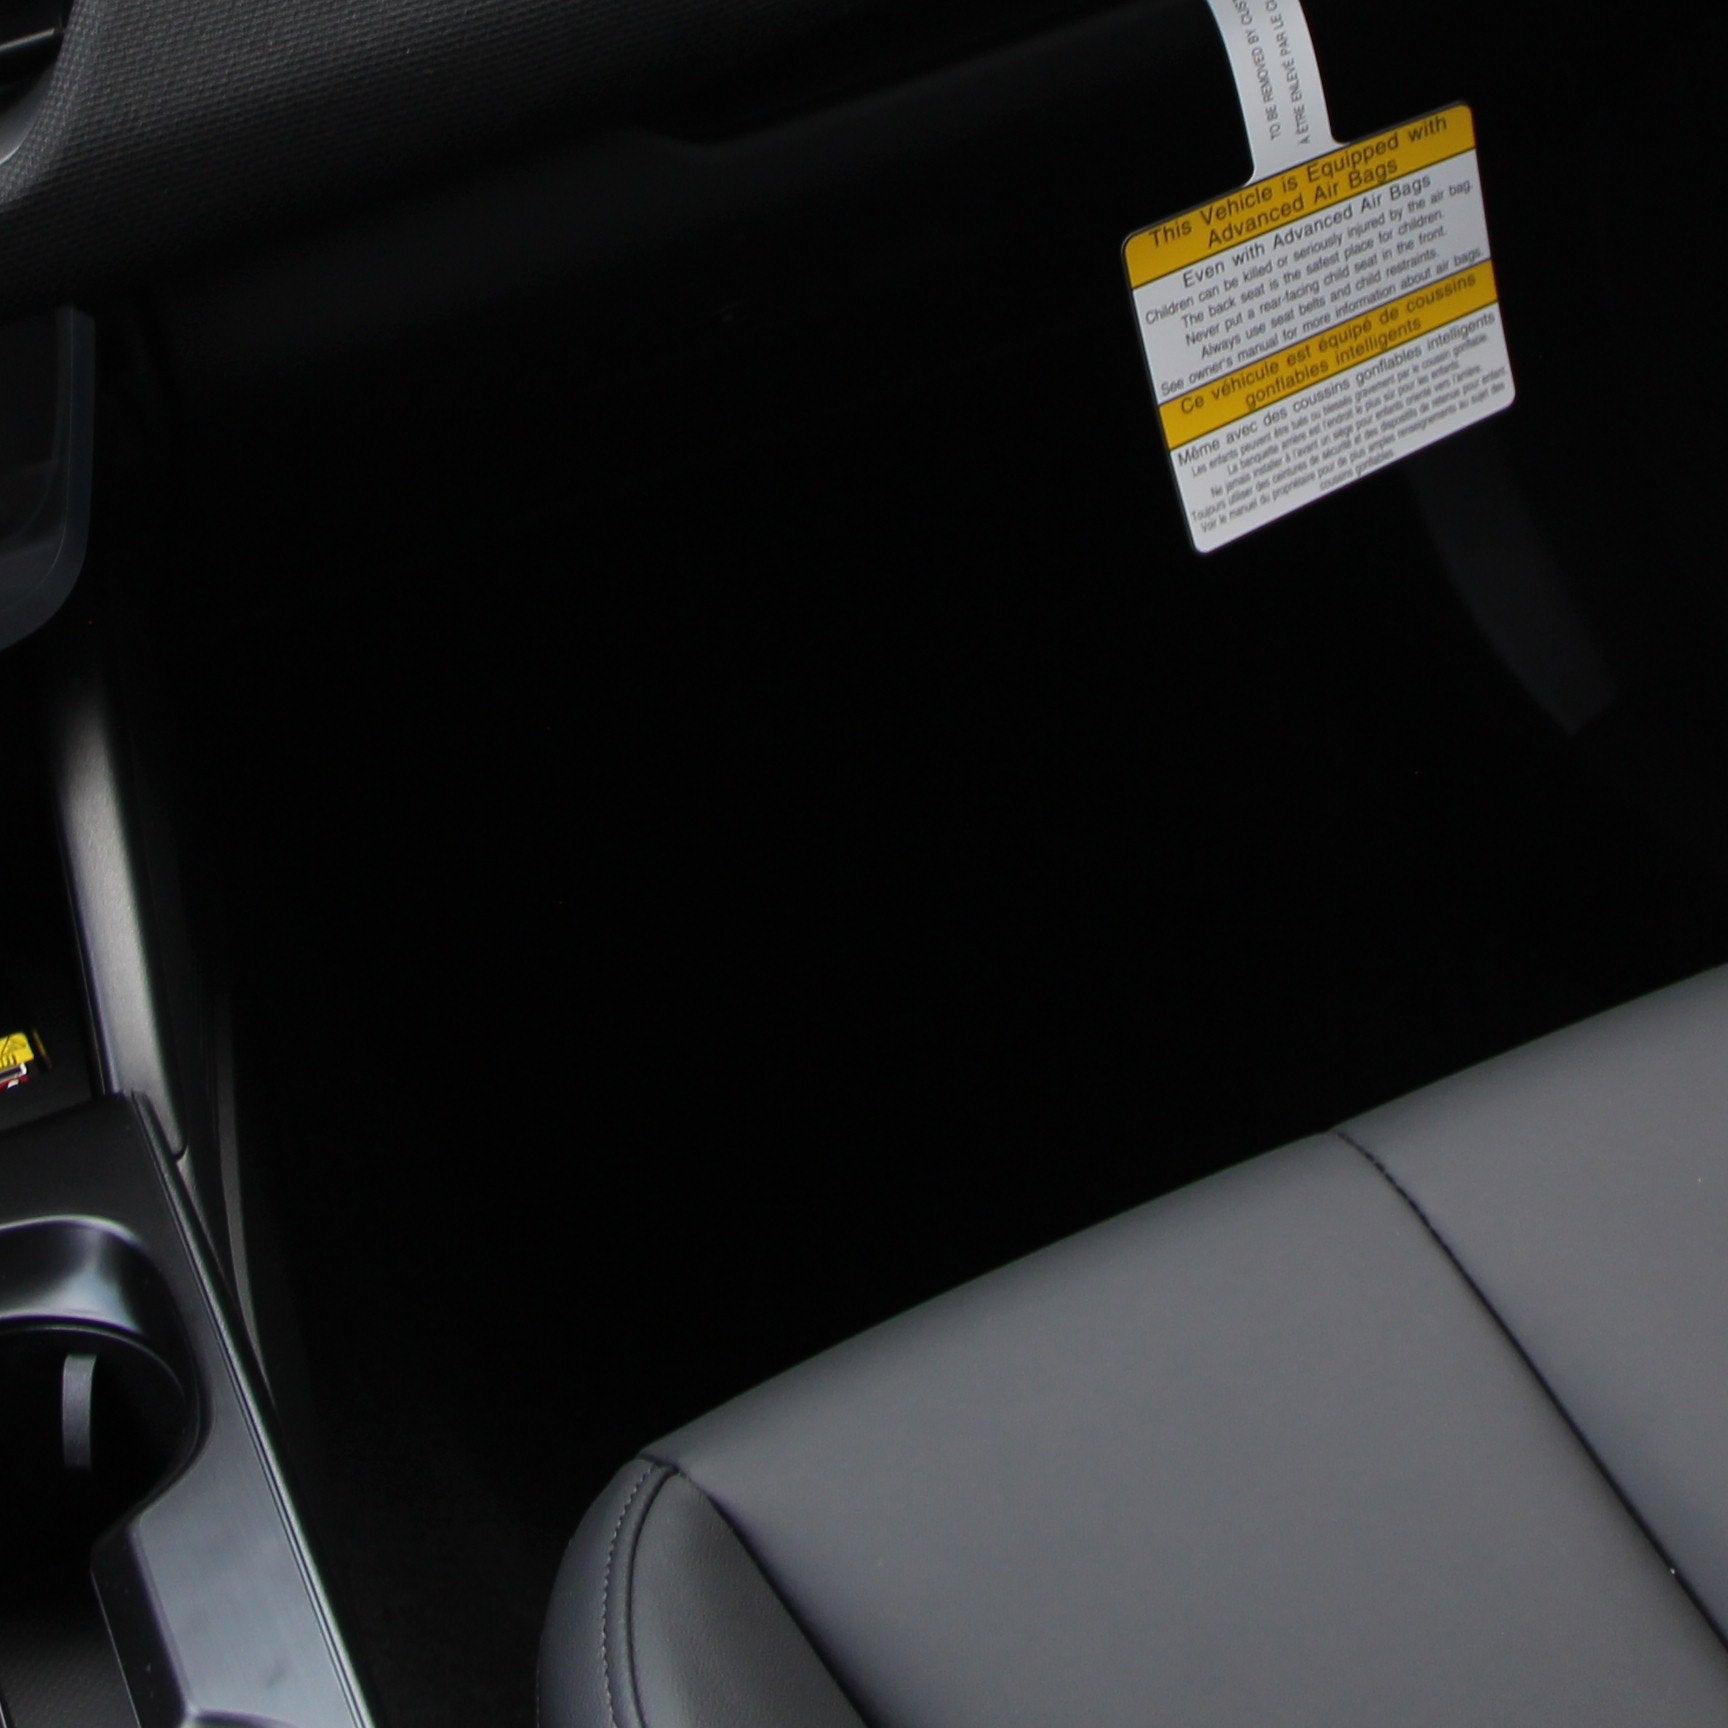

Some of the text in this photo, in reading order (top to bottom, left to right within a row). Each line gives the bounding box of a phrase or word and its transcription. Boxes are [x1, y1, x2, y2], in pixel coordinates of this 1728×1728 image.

[1246, 30, 1258, 45] BY
[1251, 48, 1273, 103] REMOVED
[1271, 14, 1283, 30] LE
[1277, 34, 1290, 57] PAR
[1266, 105, 1278, 122] BE
[1270, 125, 1280, 140] TO
[1150, 114, 1446, 247] This Vehicle is Equipped with
[1182, 176, 1429, 287] Even with Advanced Air Bags
[1207, 159, 1397, 247] Advanced Air Bags
[1143, 181, 1471, 324] Children can be killed or seriously injured by the air bag.
[1181, 210, 1443, 327] The back seat is the safest place for children.
[1186, 225, 1445, 344] Never put a rear-facing child seat in the front.
[1200, 249, 1437, 358] Always use seat belts and child restraints.
[1160, 248, 1482, 395] See owner's manual for more information about air bags.
[1180, 274, 1475, 414] Ce véhicule est équipé de coussins
[1246, 318, 1420, 410] gonflables intelligents
[1177, 313, 1493, 465] Même avec des coussins gonflables intelligents
